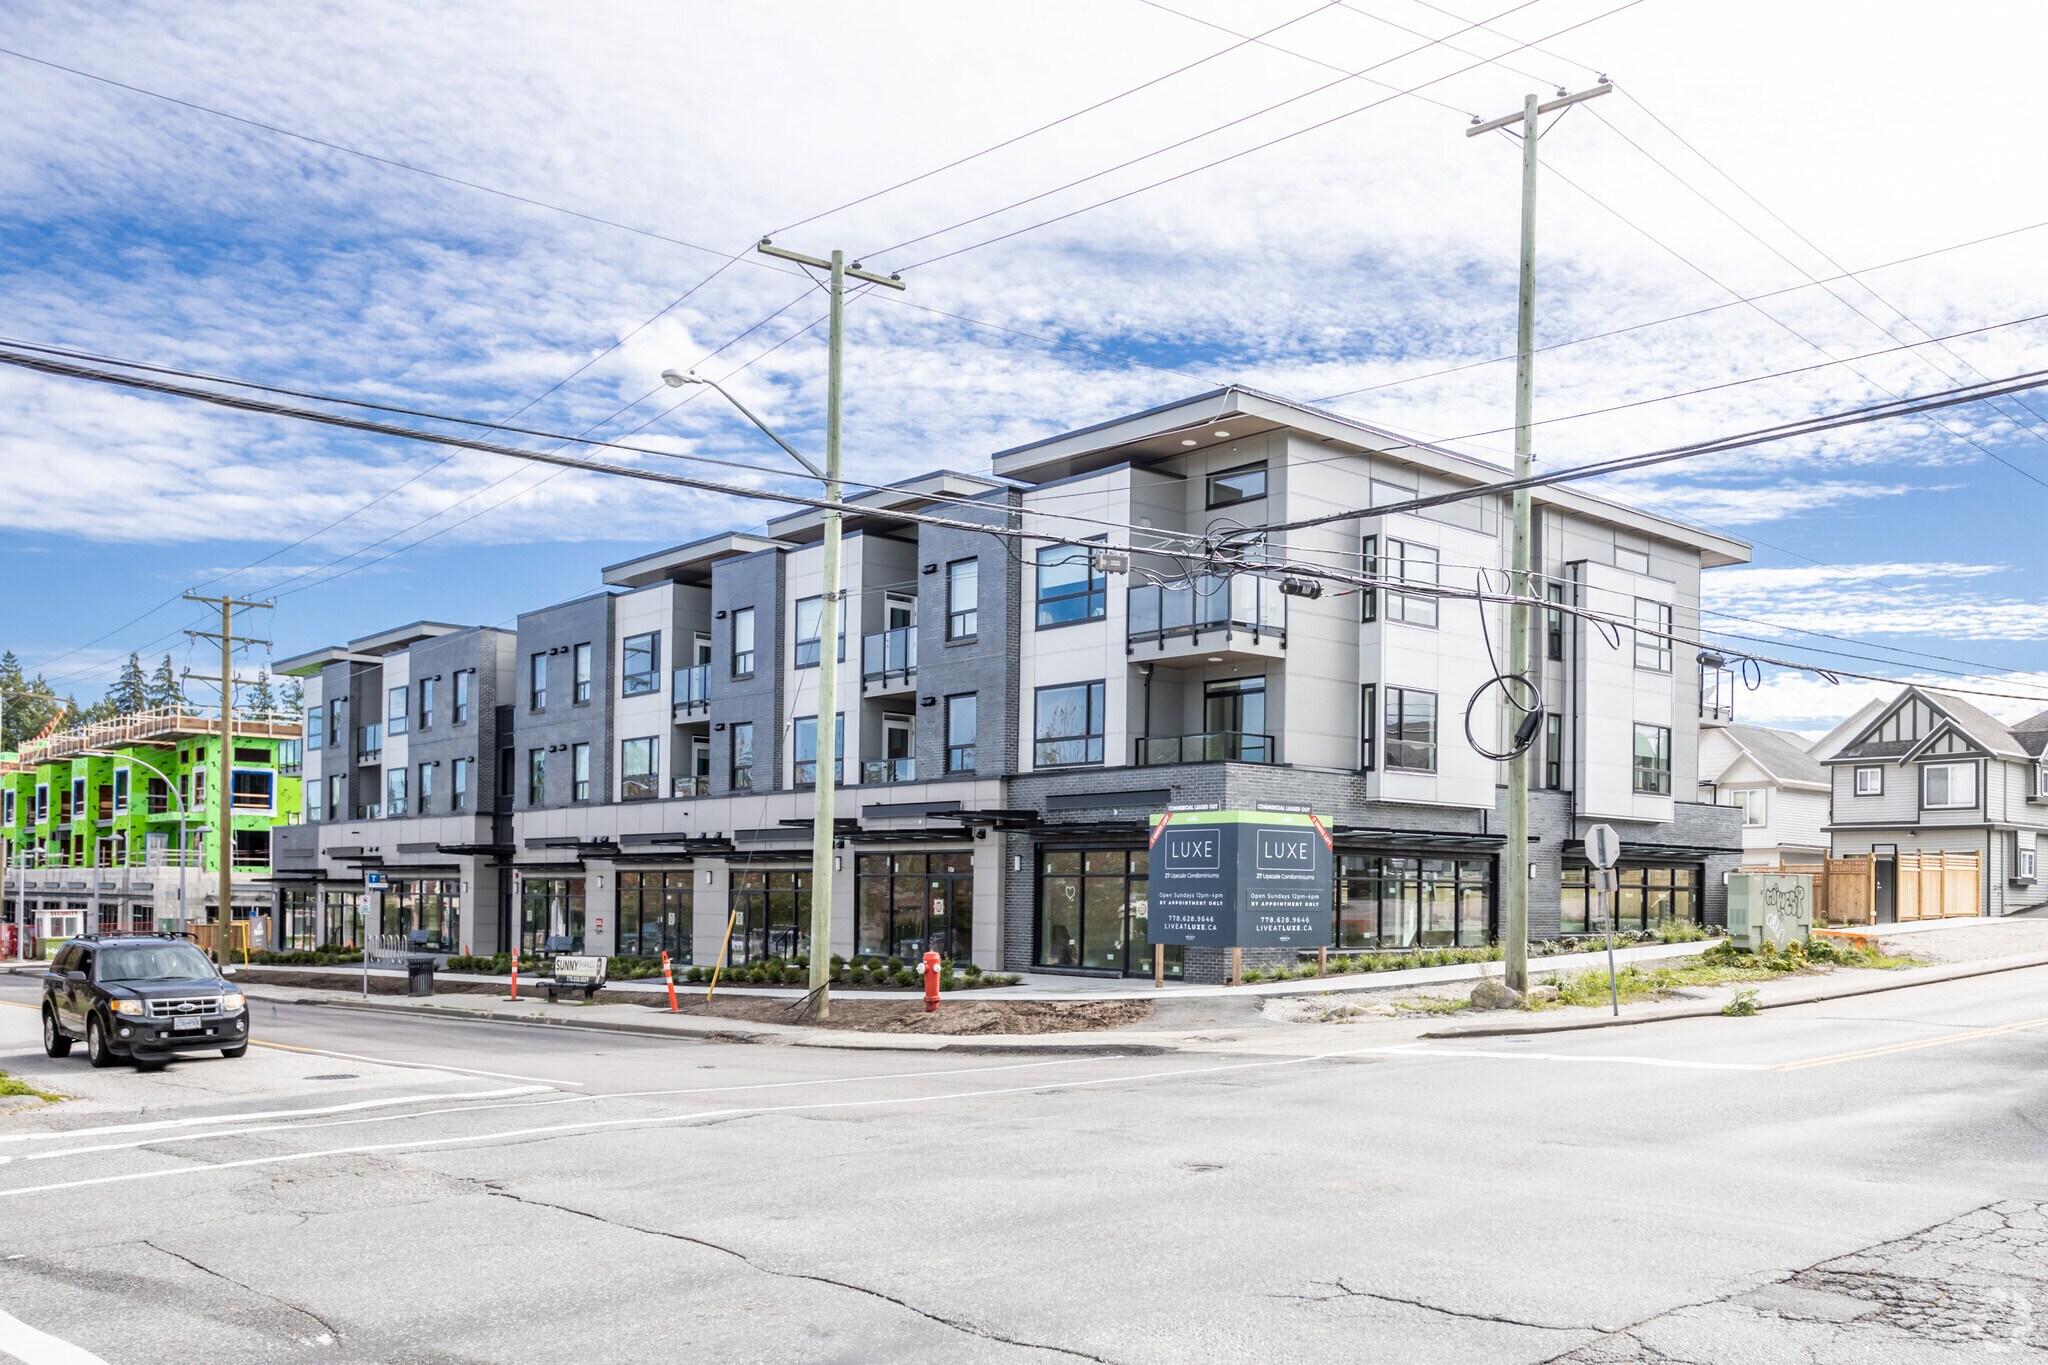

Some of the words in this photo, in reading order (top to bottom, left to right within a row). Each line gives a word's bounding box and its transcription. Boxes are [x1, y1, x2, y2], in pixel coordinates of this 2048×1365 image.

[1172, 841, 1212, 858] LUXE
[1265, 842, 1308, 860] LUXE
[556, 960, 579, 971] SUNNY
